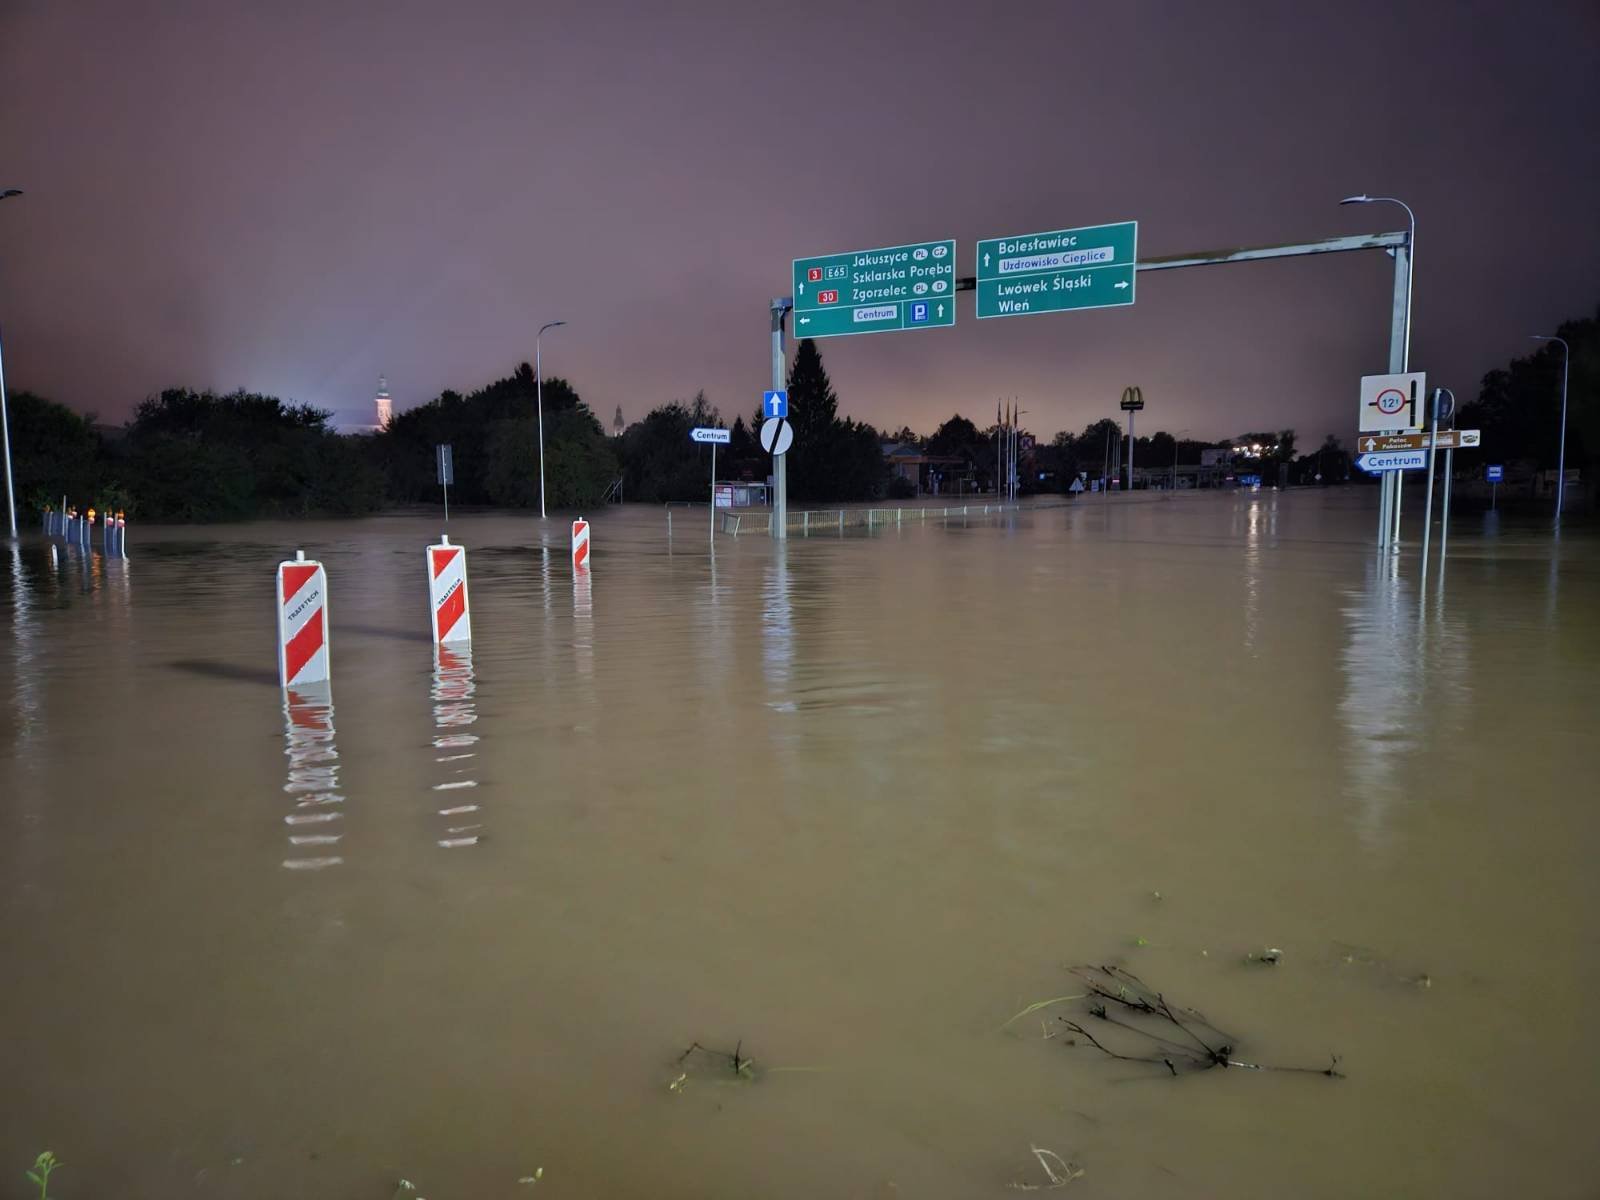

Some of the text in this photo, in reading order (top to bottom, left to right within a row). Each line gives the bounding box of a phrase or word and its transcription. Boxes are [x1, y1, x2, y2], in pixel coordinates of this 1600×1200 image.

[999, 235, 1077, 255] Bolesławiec
[852, 248, 945, 268] Jakuszyce PL CZ
[1003, 251, 1106, 271] Uzdrowisko Cieplice
[812, 270, 818, 280] 3
[828, 267, 845, 278] E65
[853, 263, 952, 284] Szklarska Poręba
[852, 282, 943, 302] Zgorzelec PL D
[998, 274, 1091, 296] Lwówek Śląski
[822, 292, 834, 302] 30
[999, 298, 1029, 312] Wleń
[856, 309, 894, 320] Centrum
[696, 431, 728, 440] Centrum
[1368, 456, 1422, 468] Centrum
